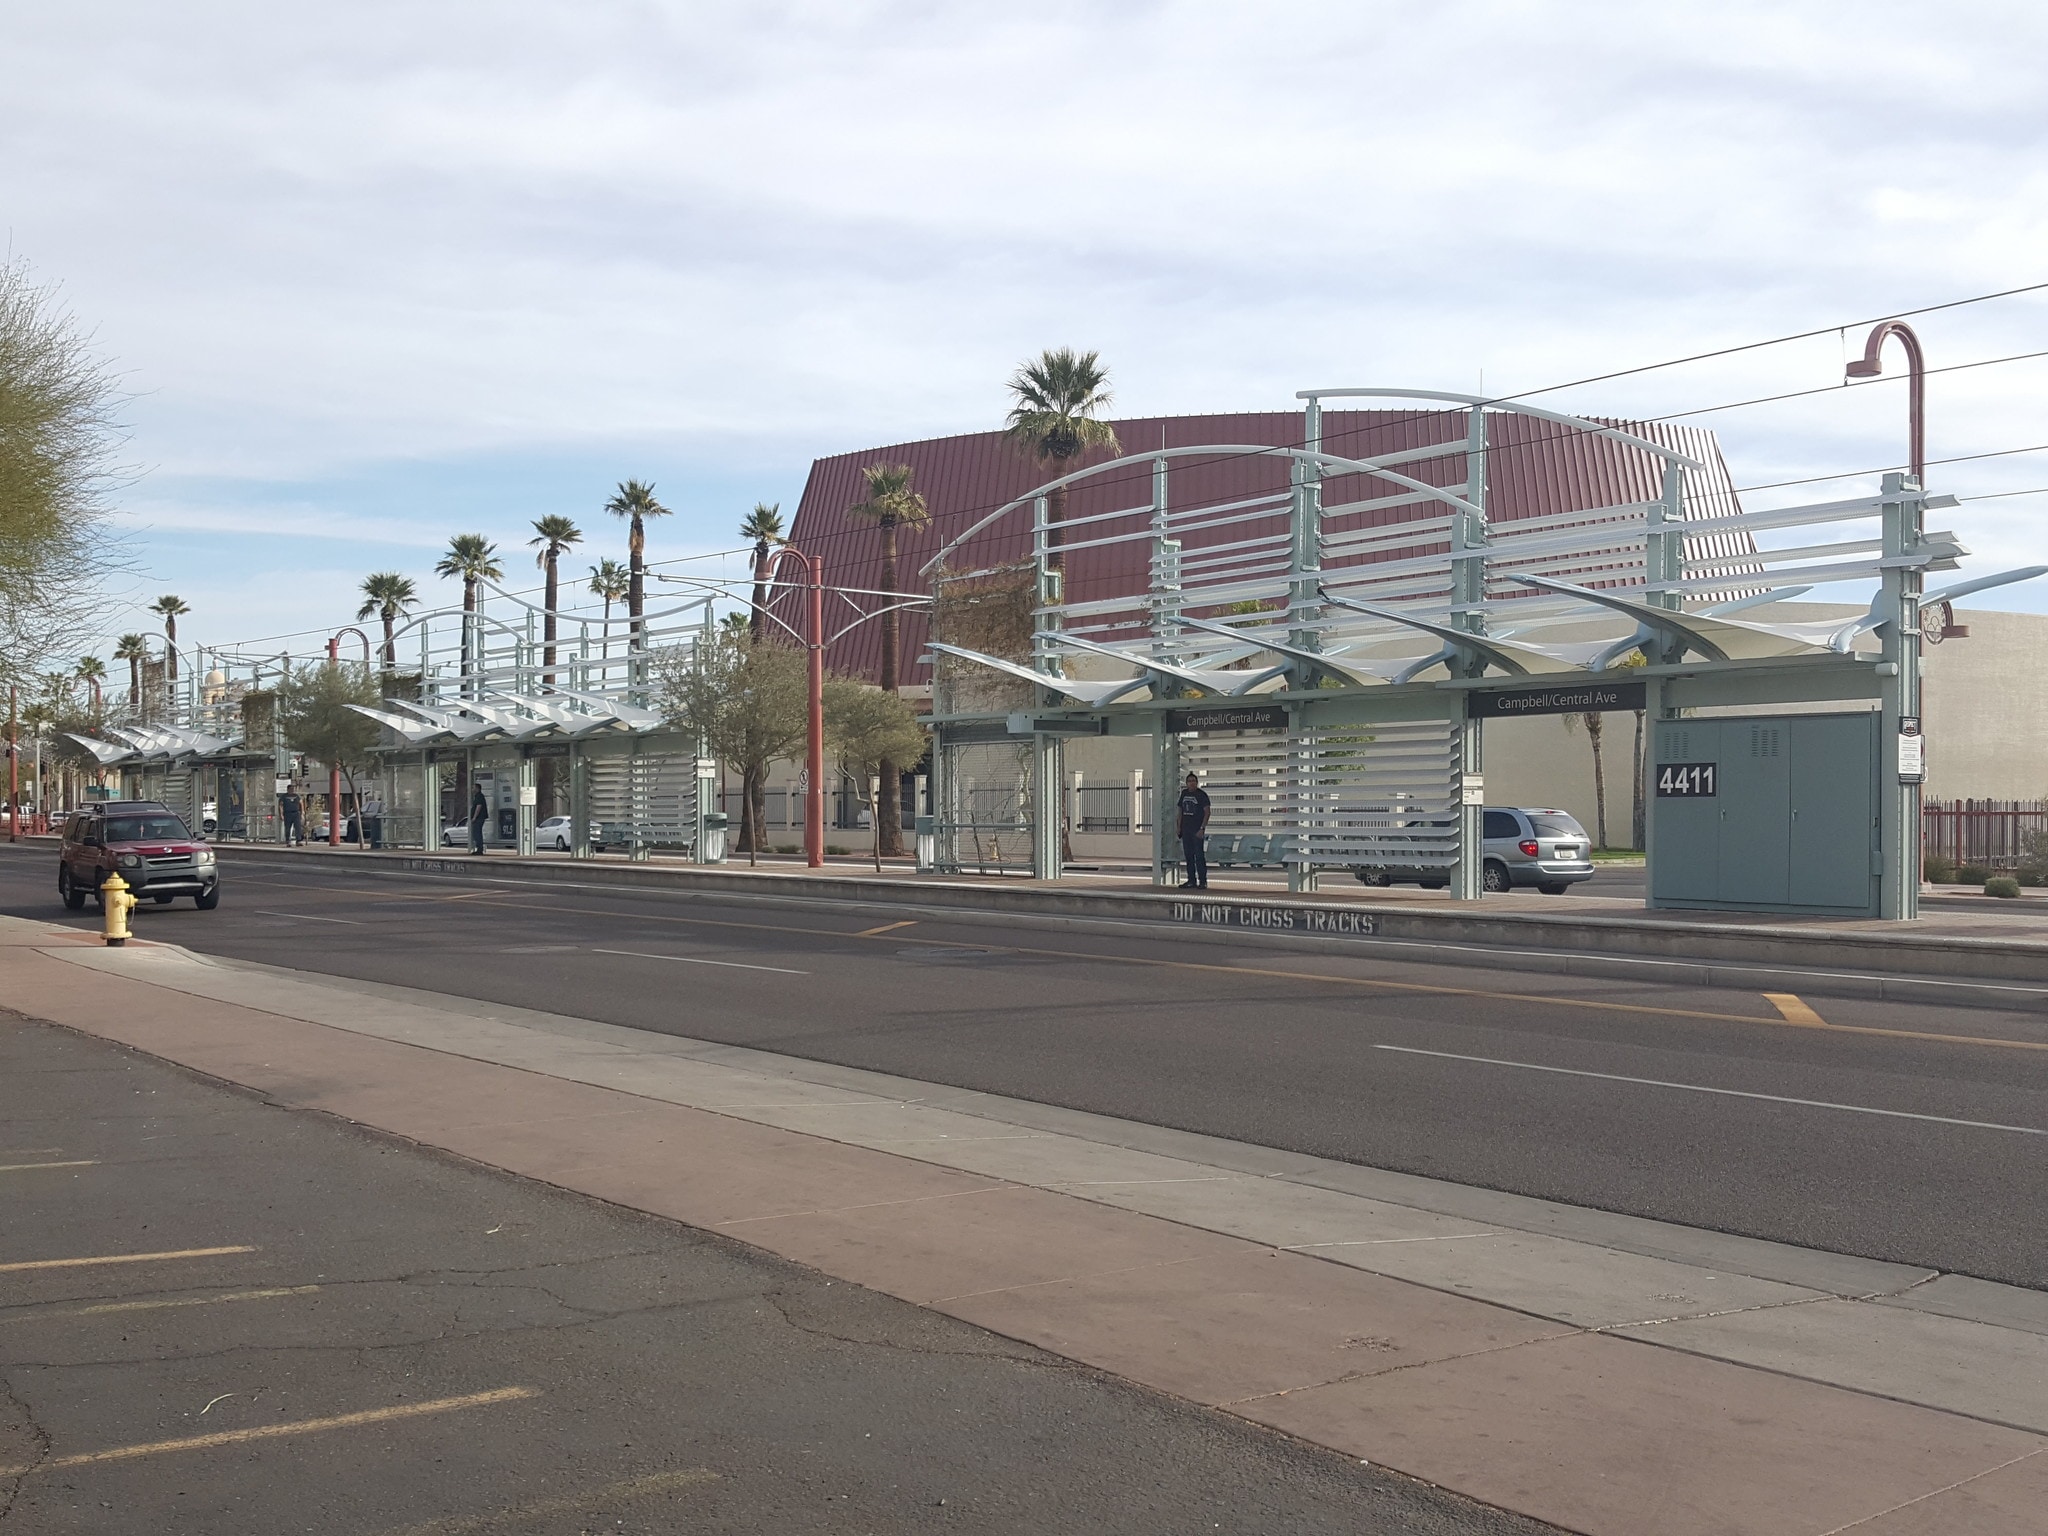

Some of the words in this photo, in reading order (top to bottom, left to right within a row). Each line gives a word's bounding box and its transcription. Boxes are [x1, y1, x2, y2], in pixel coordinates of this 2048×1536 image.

[1497, 692, 1592, 710] Campbell/Central
[1595, 692, 1617, 704] Ave
[1186, 713, 1253, 727] Campbell/Central
[1255, 712, 1271, 723] Ave
[1659, 766, 1714, 794] 4411
[1174, 903, 1193, 920] DO
[1201, 905, 1232, 924] NOT
[1240, 907, 1294, 929] CROSS
[1304, 910, 1374, 934] TRACKS
